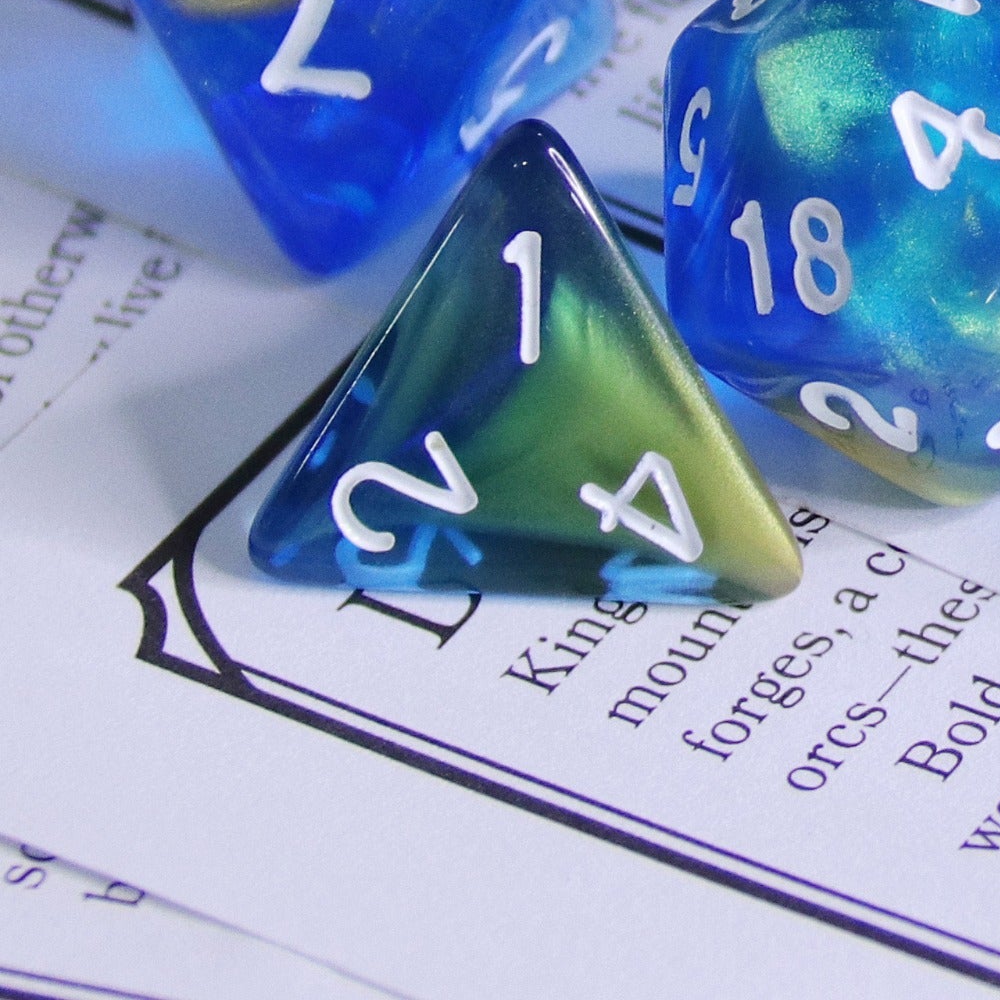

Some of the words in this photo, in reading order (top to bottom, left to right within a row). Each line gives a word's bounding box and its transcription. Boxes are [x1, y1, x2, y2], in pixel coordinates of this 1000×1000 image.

[500, 230, 544, 365] 1
[731, 196, 853, 316] 18
[799, 380, 919, 454] 2
[330, 430, 479, 553] 2
[579, 450, 704, 563] 4
[682, 626, 853, 763] forges,
[833, 586, 879, 614] a
